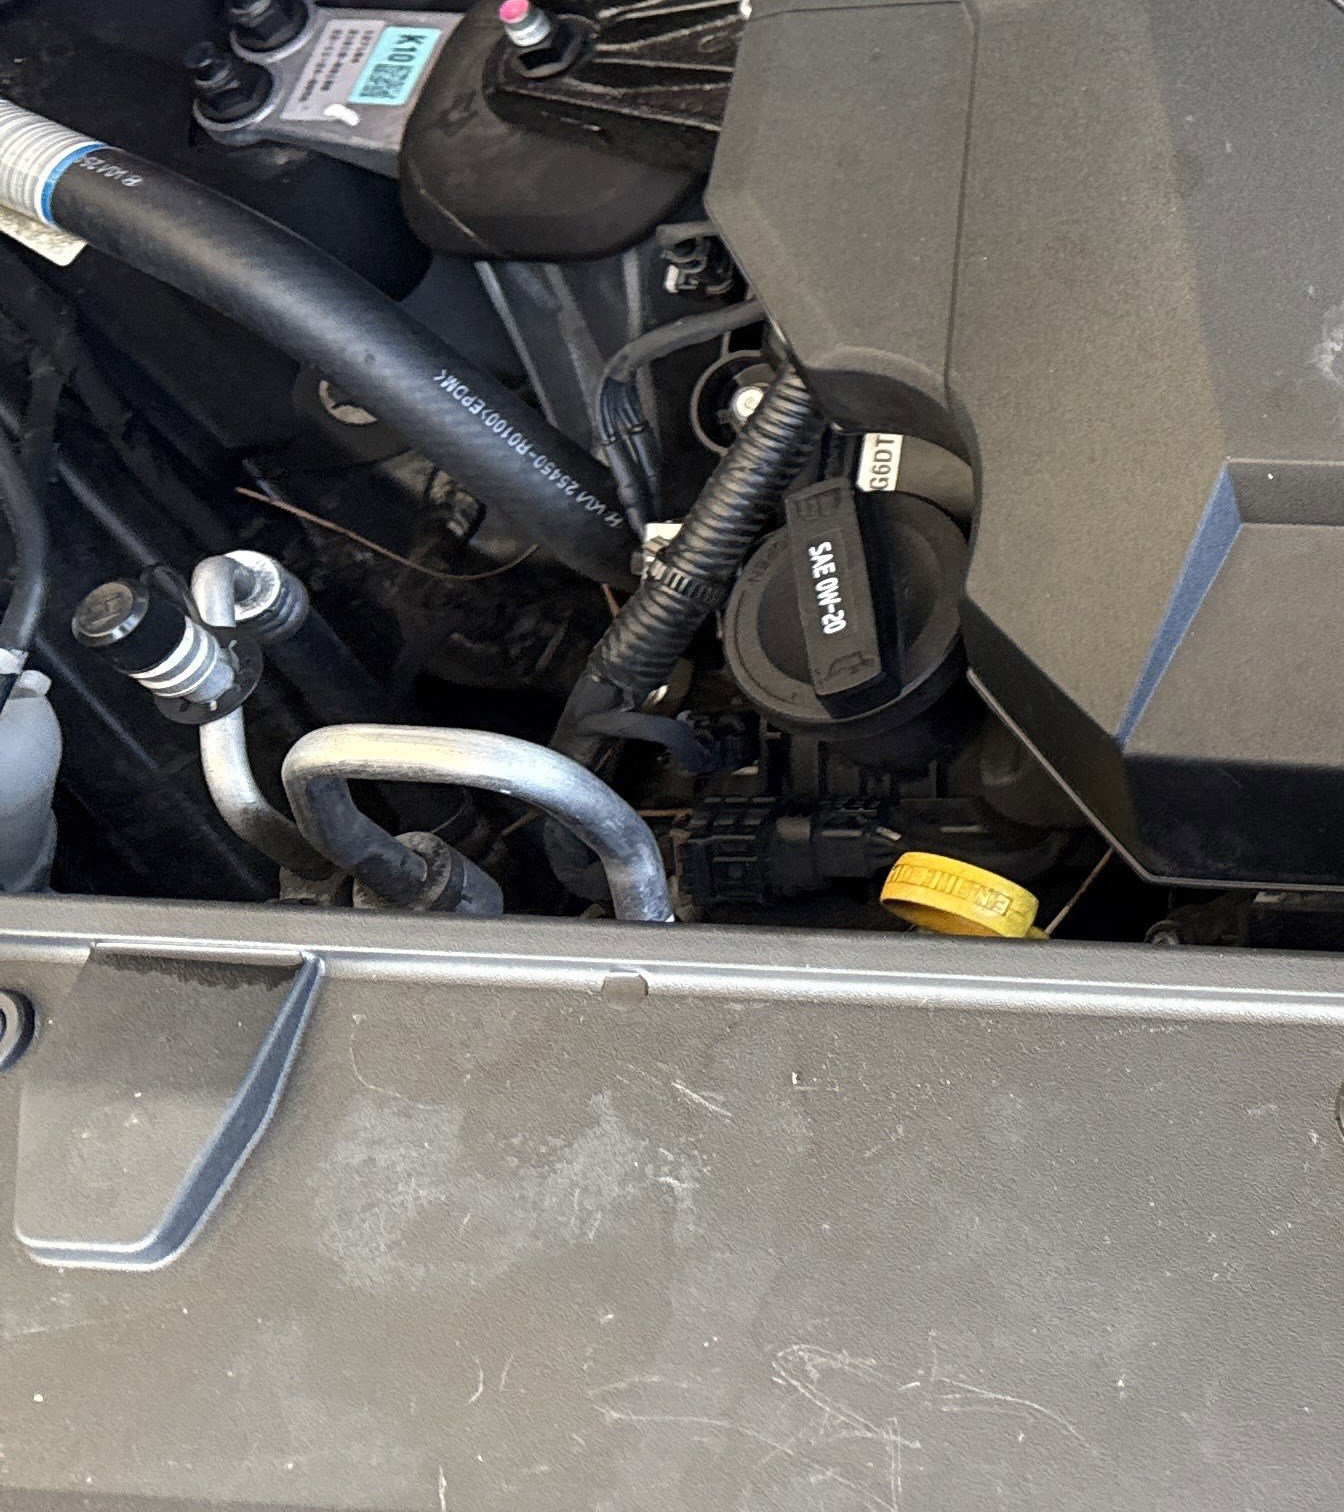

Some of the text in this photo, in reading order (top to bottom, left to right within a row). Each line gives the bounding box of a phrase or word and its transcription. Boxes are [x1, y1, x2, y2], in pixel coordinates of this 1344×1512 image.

[386, 33, 429, 64] K10
[868, 435, 896, 492] G6DT
[808, 541, 848, 636] SAE 0W-20
